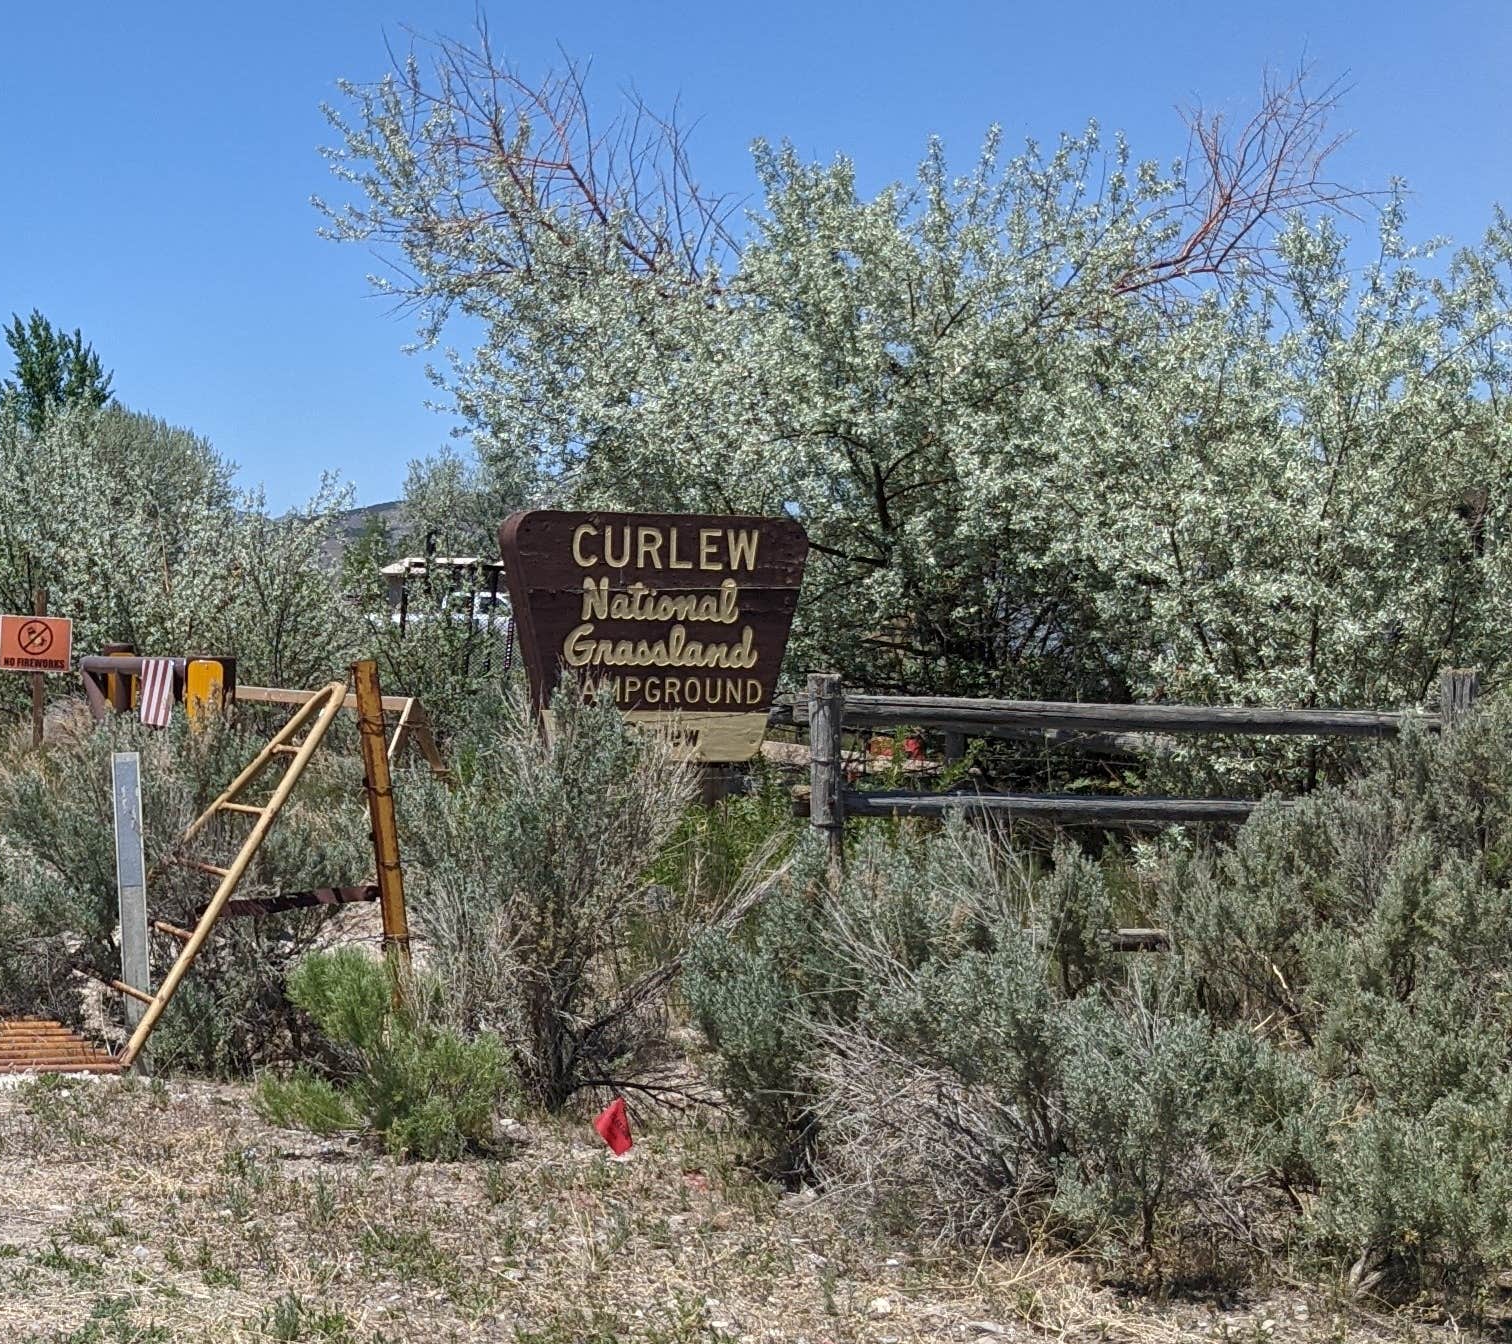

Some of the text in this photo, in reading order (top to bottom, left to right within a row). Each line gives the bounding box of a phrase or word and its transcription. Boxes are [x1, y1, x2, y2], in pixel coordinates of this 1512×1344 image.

[572, 523, 759, 571] CURLEW
[581, 576, 739, 624] National
[3, 657, 65, 669] NO FIREWORKS
[563, 623, 758, 669] Grassland
